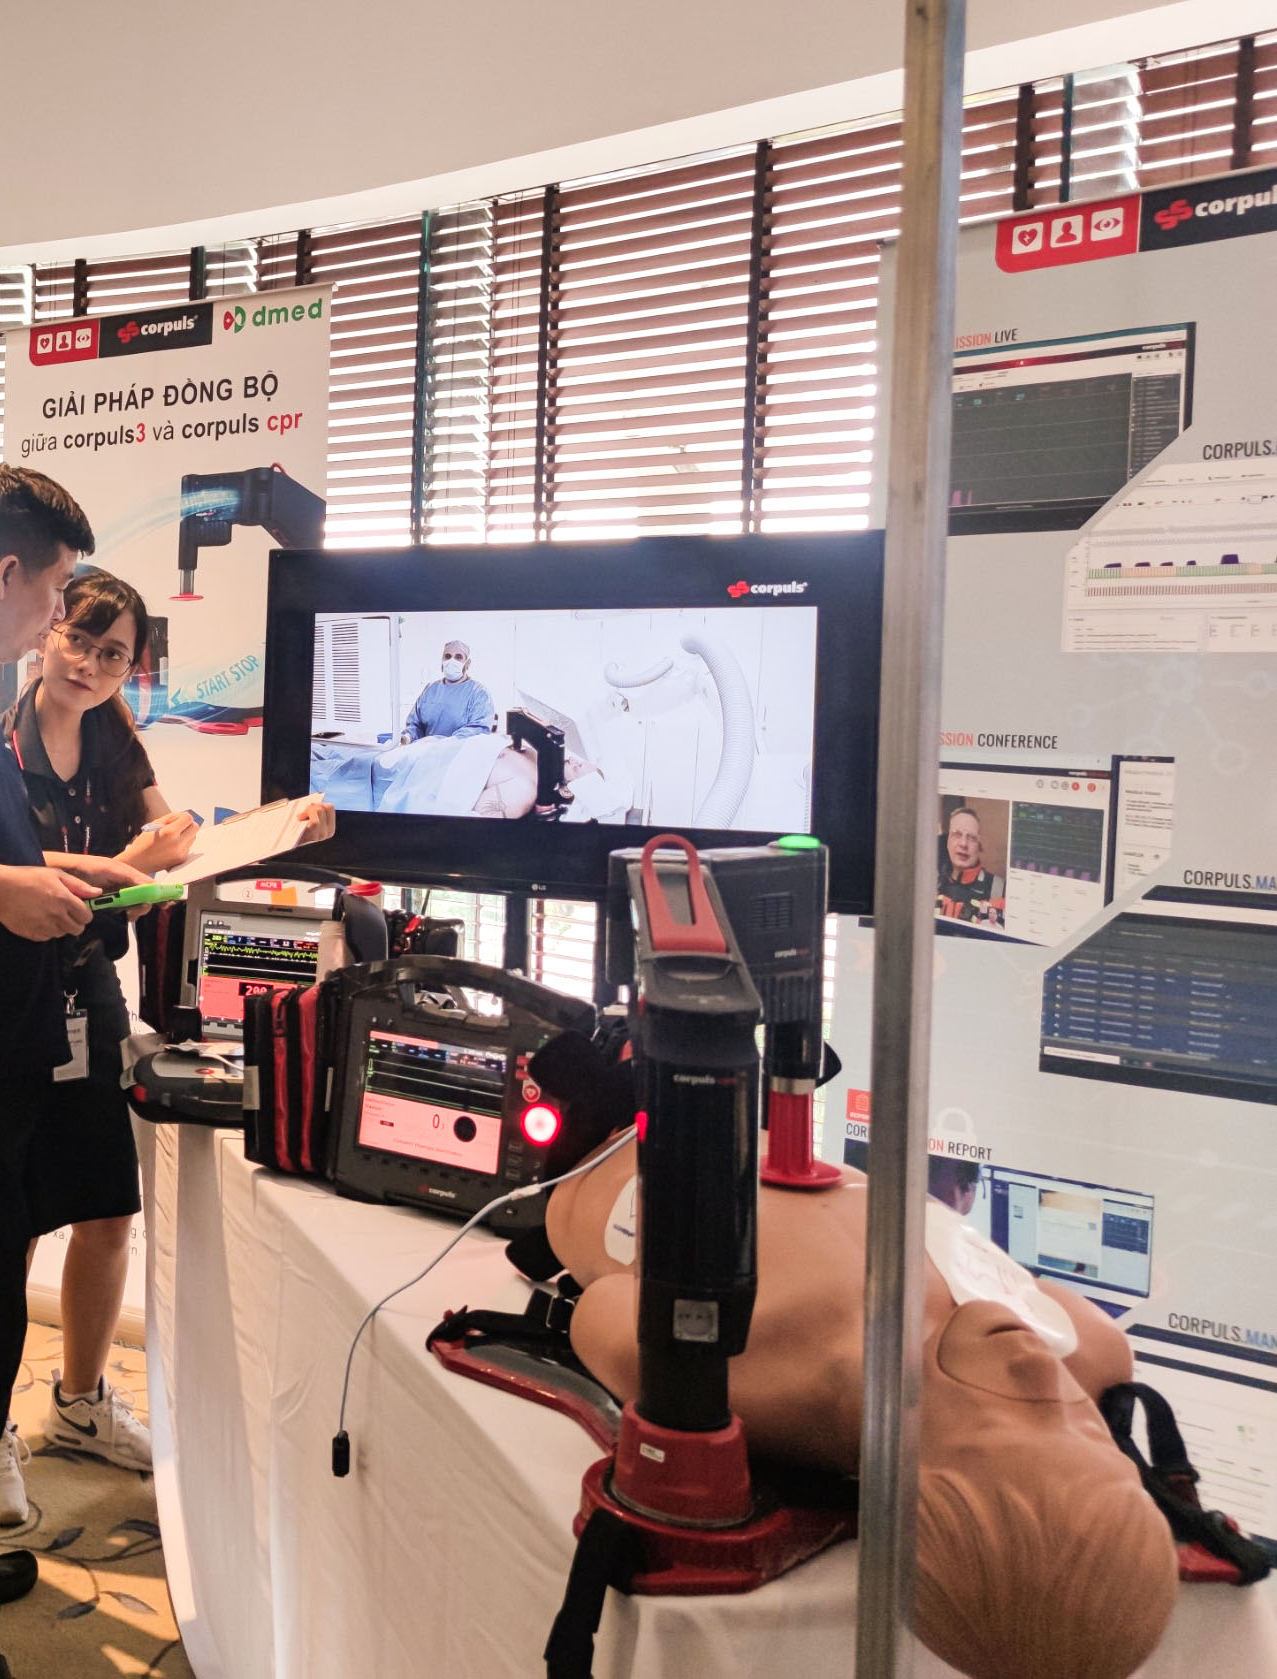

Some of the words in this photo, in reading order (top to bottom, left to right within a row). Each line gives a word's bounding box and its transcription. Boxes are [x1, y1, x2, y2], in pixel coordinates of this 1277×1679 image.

[1195, 184, 1277, 216] corpul
[252, 298, 323, 328] dmed
[955, 331, 992, 350] ISSION
[994, 328, 1018, 344] LIVE
[42, 390, 85, 419] GIẢI
[94, 383, 154, 414] PHÁP
[163, 378, 233, 407] ĐỒNG
[243, 370, 279, 402] BỘ
[21, 433, 57, 458] giữa
[63, 423, 146, 452] corpuls3
[152, 420, 174, 441] và
[181, 413, 259, 442] corpuls
[267, 412, 303, 436] cpr
[1203, 439, 1277, 461] CORPULS.
[196, 670, 231, 699] START
[228, 655, 260, 682] STOP
[939, 732, 974, 747] SSION
[977, 733, 1059, 749] CONFERENCE
[1183, 869, 1277, 891] CORPULS.MA
[846, 1122, 868, 1139] COR
[928, 1137, 944, 1152] ON
[947, 1140, 993, 1162] REPORT
[1168, 1312, 1277, 1350] CORPULS.MAN
